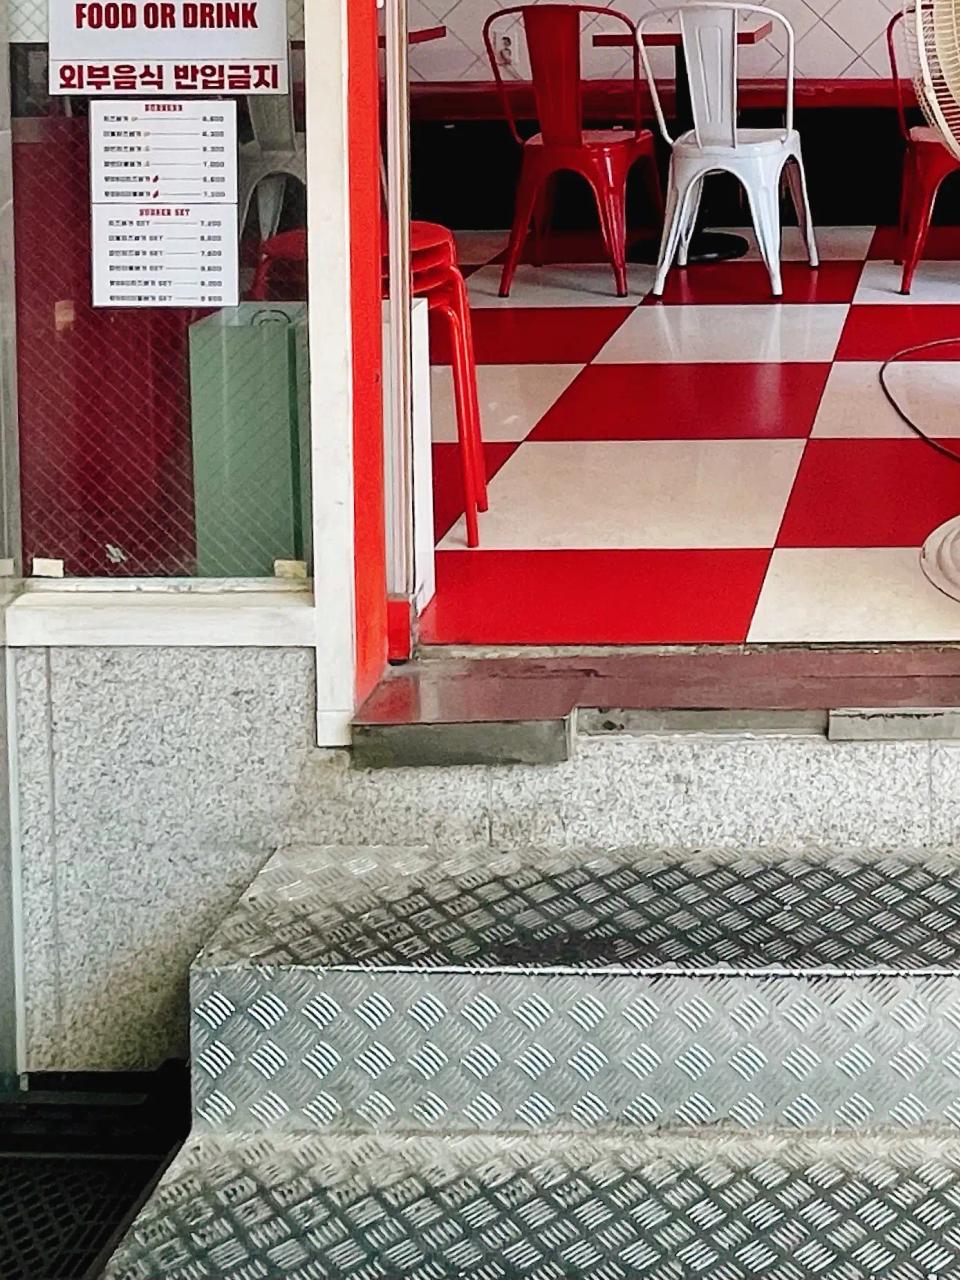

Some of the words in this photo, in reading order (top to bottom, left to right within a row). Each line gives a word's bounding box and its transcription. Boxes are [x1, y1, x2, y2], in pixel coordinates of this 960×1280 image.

[76, 3, 136, 29] FOOD
[144, 3, 175, 28] OR
[183, 2, 258, 28] DRINK
[60, 65, 163, 90] 외부음식
[174, 65, 278, 89] 반입금지
